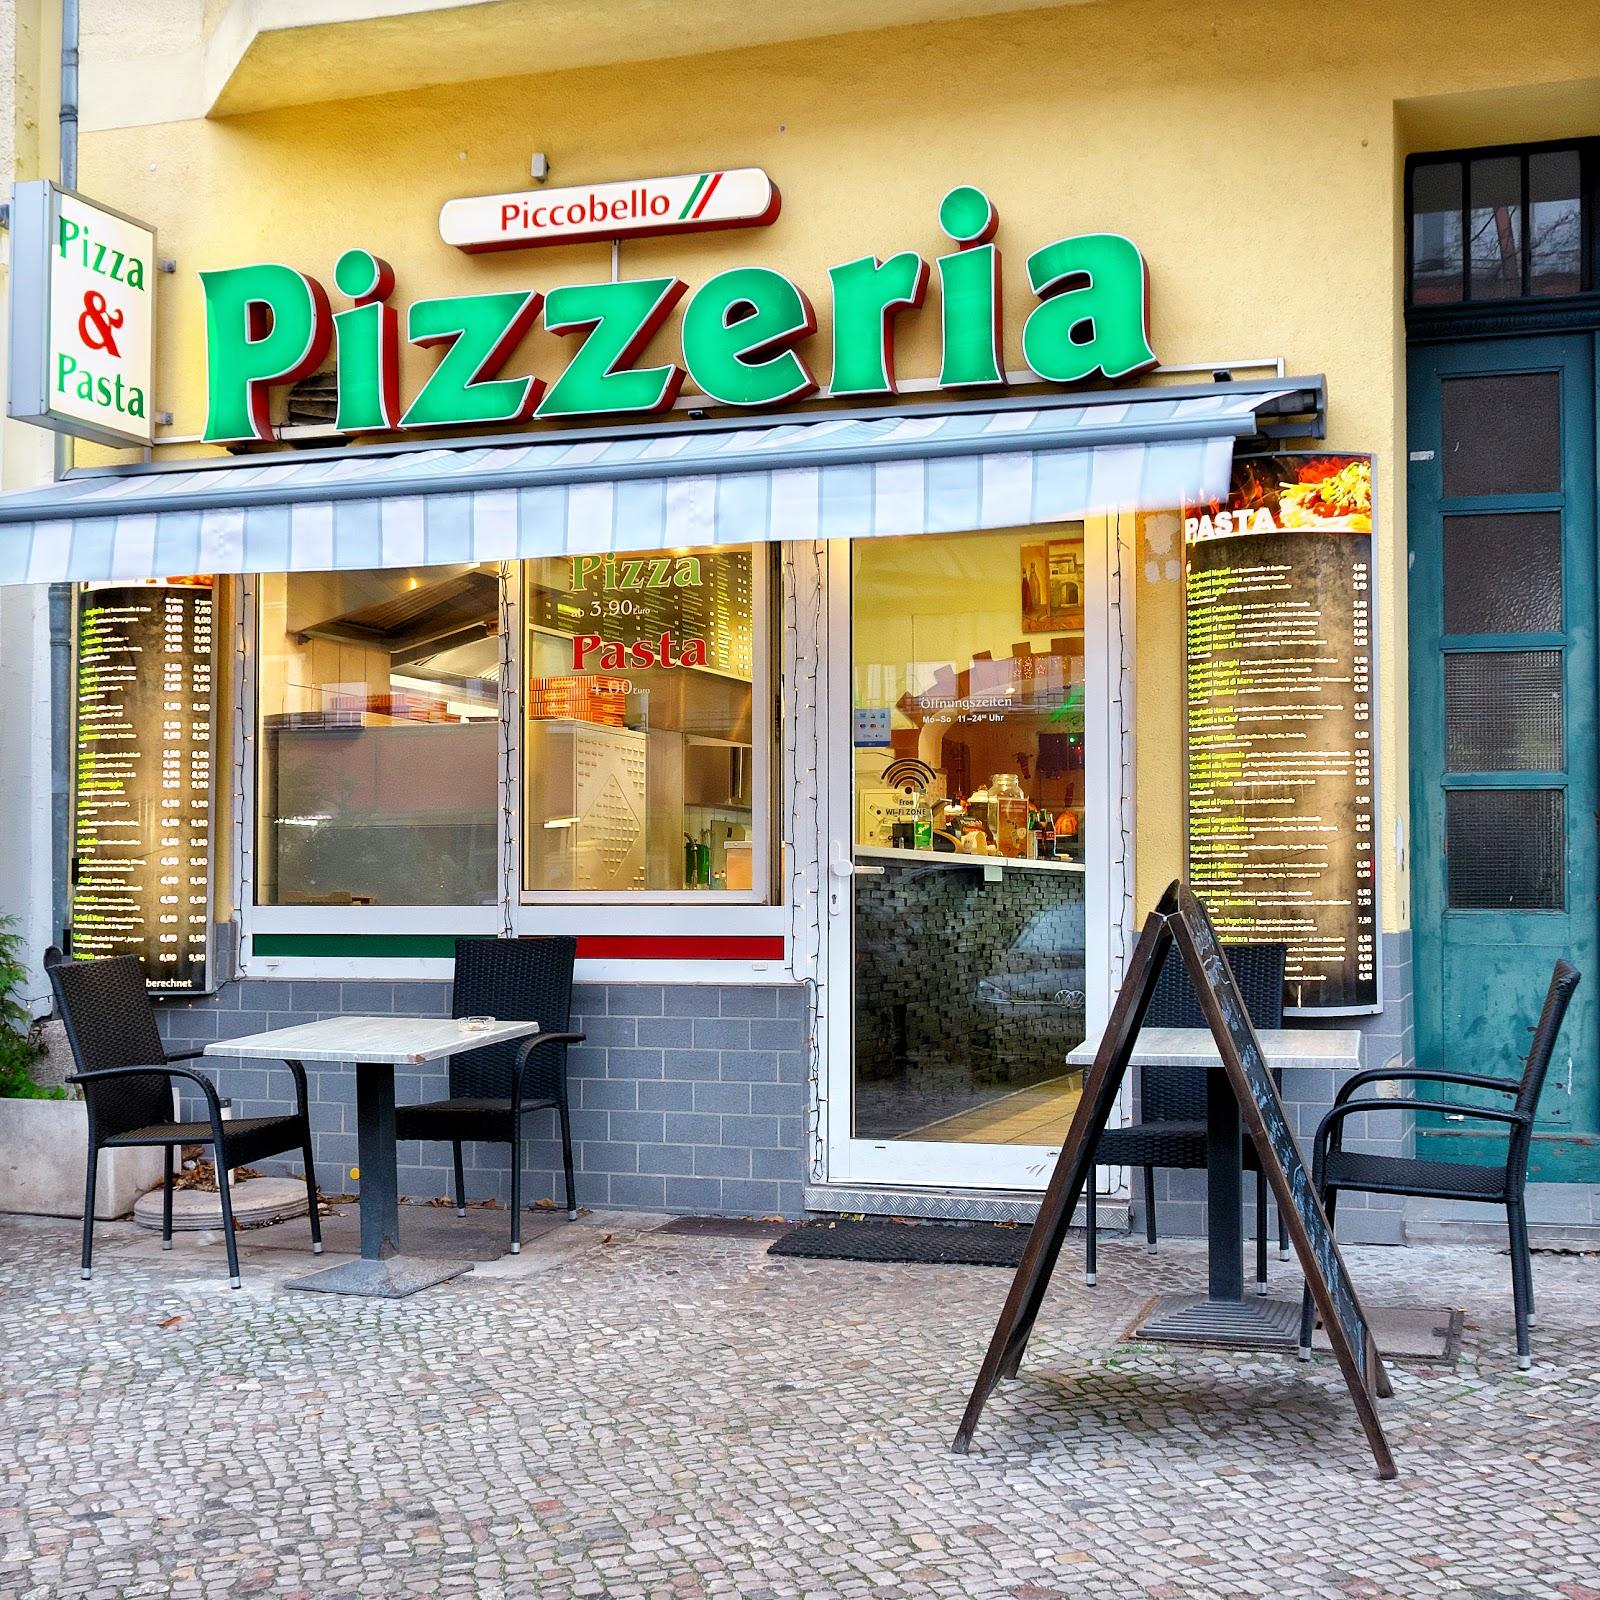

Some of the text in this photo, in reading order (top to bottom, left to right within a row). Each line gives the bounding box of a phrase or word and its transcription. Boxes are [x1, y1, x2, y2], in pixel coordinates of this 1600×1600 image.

[500, 187, 670, 232] Piccobello
[58, 214, 146, 293] Pizza
[77, 289, 124, 358] &
[201, 185, 1160, 446] Pizzeria
[56, 352, 146, 420] Pasta
[1185, 507, 1277, 543] PASTA
[571, 552, 704, 593] Pizza
[194, 606, 212, 614] 7,00
[590, 599, 632, 618] 3,90
[572, 631, 709, 671] Pasta
[920, 696, 1012, 710] Öffnungszeiten
[989, 713, 1005, 722] Uhr
[906, 808, 926, 816] ZONE
[1357, 916, 1372, 925] 7,50
[145, 978, 193, 988] berechnet
